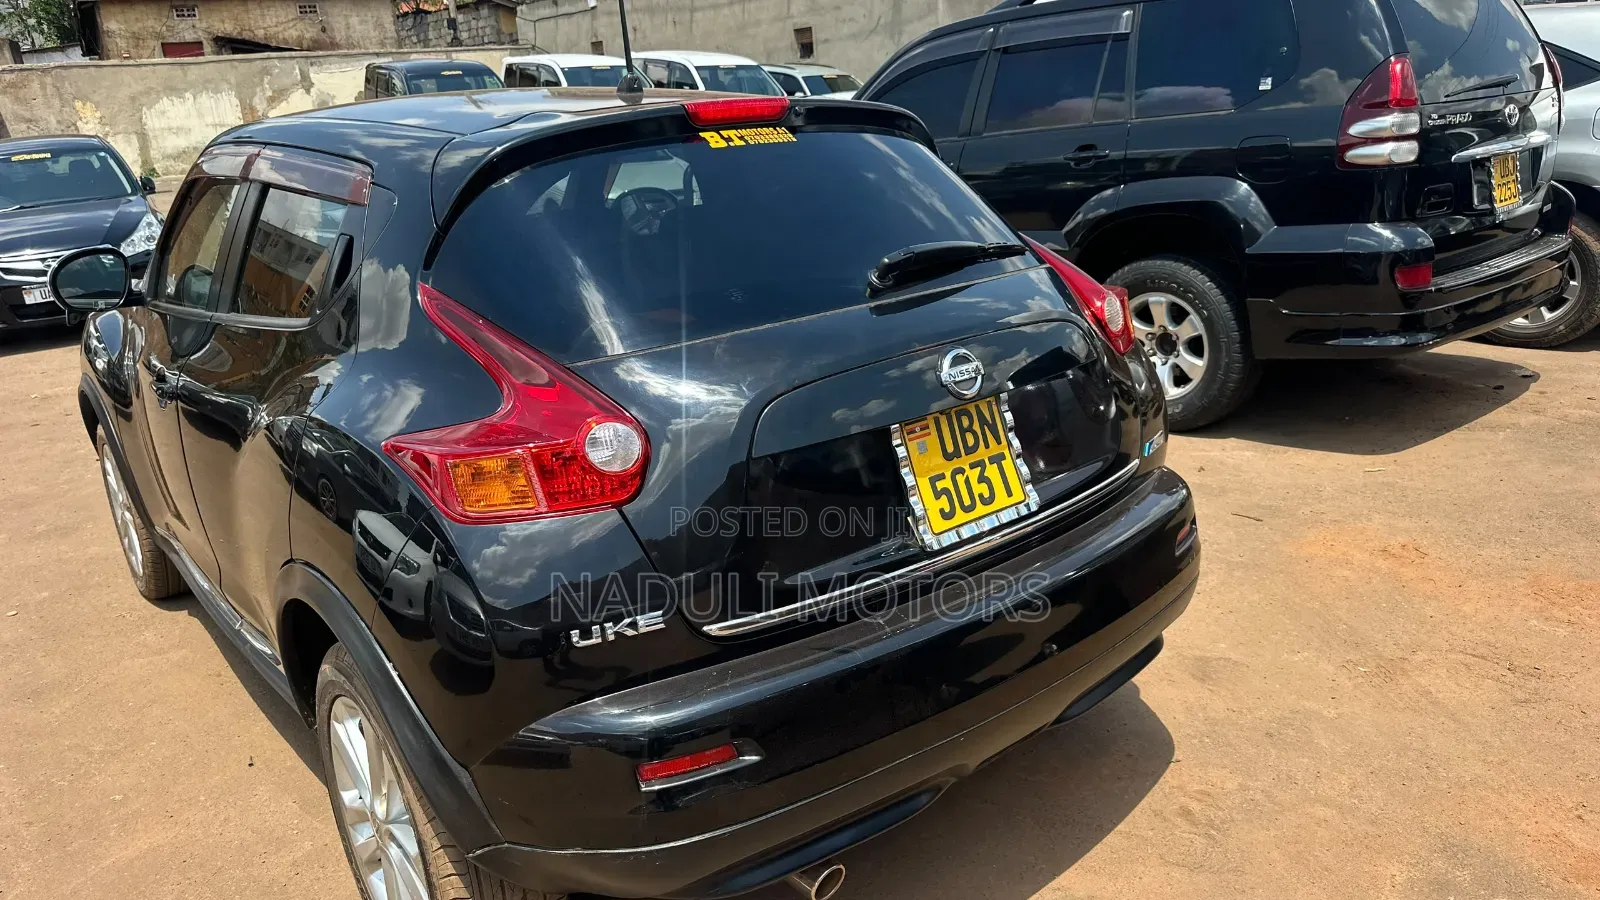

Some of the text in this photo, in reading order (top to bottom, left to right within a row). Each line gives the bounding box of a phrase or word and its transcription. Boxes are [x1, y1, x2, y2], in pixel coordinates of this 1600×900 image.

[1500, 155, 1516, 179] UBJ
[1497, 179, 1518, 203] 225J
[934, 400, 1002, 462] UBN
[928, 452, 1013, 521] 503T
